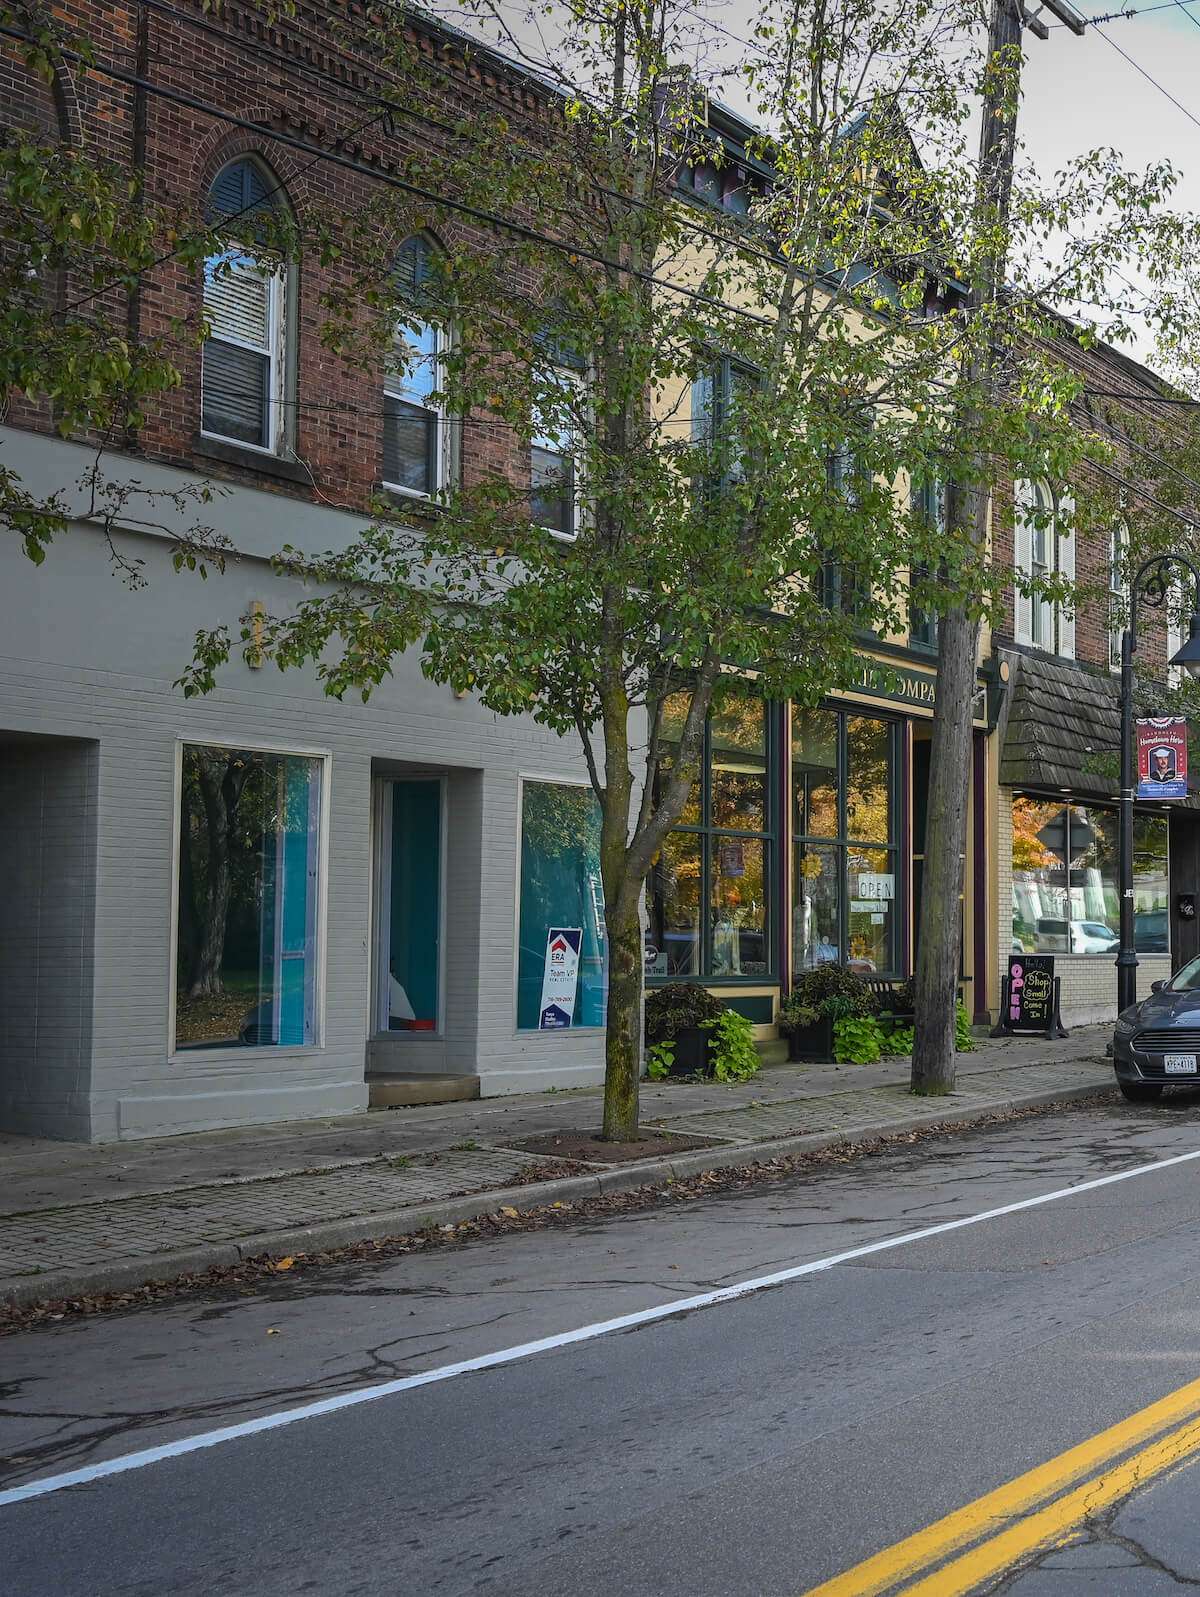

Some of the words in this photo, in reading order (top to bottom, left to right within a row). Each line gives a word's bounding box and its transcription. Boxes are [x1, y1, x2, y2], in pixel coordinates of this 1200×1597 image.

[1140, 735, 1169, 746] Hometown
[1170, 734, 1184, 745] Hero
[860, 881, 891, 898] OPEN
[551, 953, 565, 961] ERA
[550, 969, 566, 978] Team
[566, 969, 575, 977] VP
[1028, 975, 1049, 991] Shop
[1011, 964, 1024, 1020] OPEN
[1026, 988, 1047, 998] Small
[1024, 1001, 1042, 1009] Come
